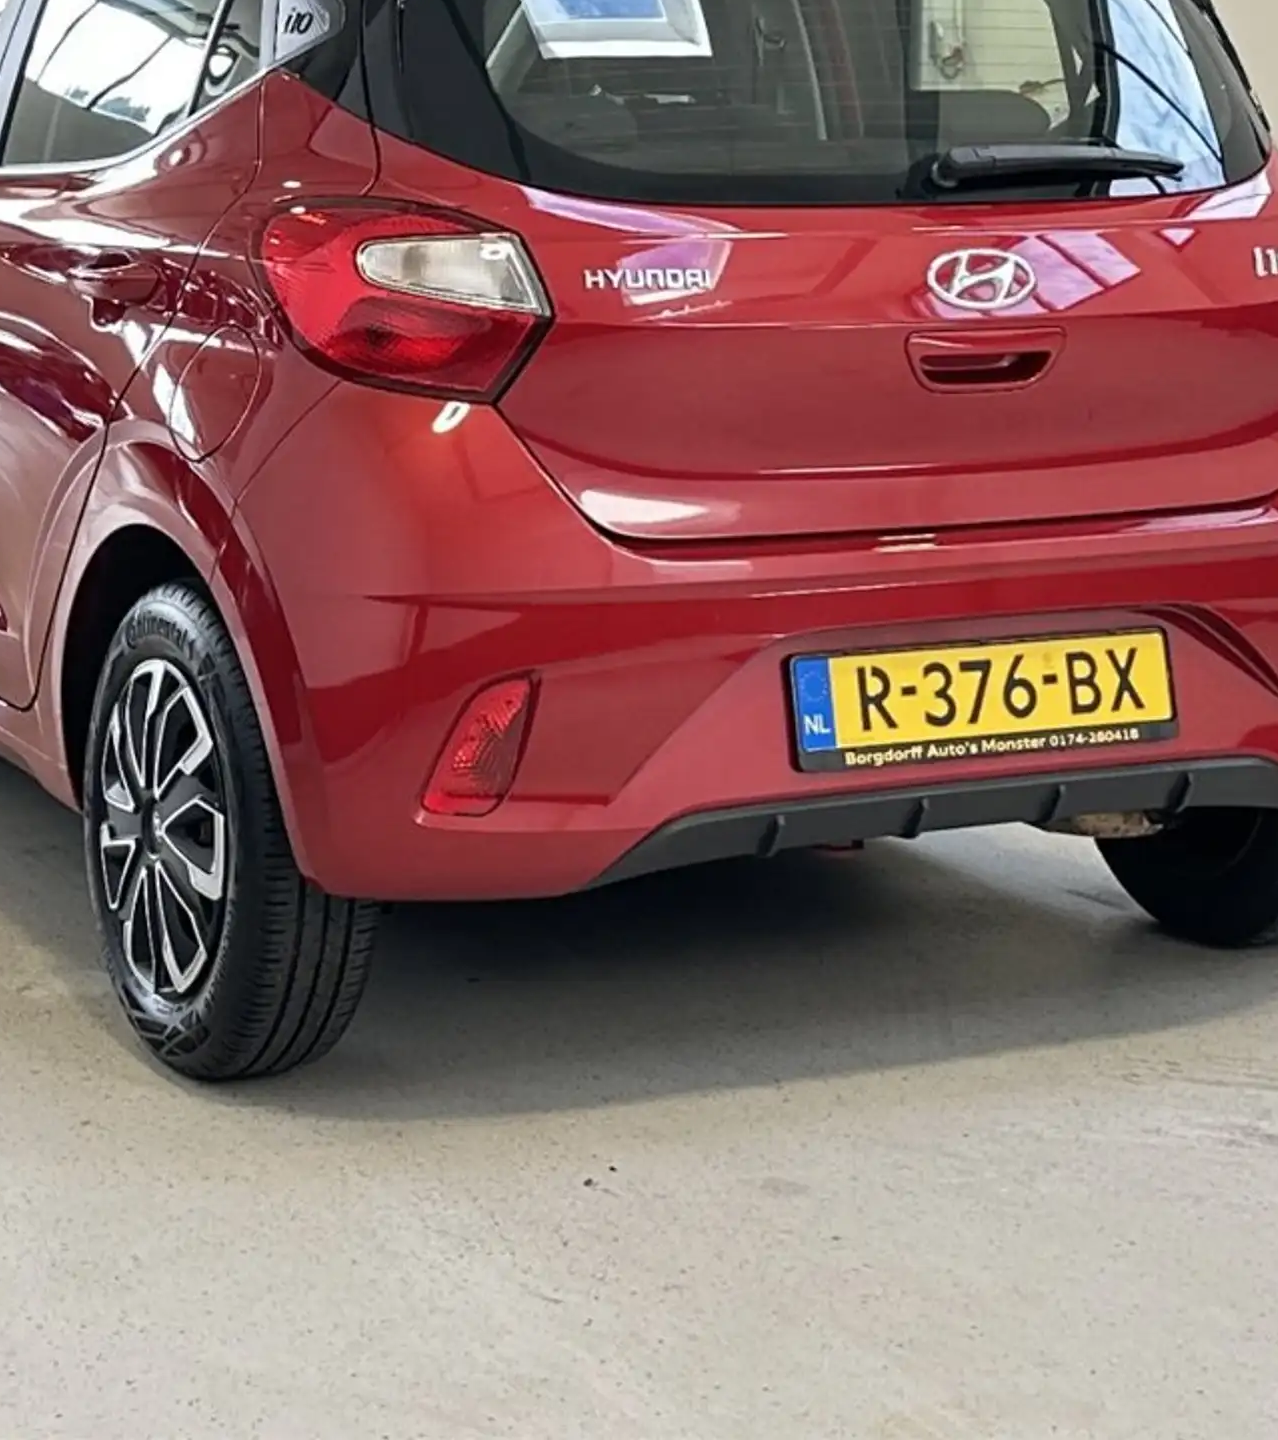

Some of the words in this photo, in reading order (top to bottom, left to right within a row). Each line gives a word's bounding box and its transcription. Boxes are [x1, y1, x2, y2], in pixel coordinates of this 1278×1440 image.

[283, 7, 314, 34] i10
[583, 268, 712, 290] HYUNDAI
[856, 647, 1145, 732] R-376-BX
[803, 713, 831, 735] NL
[844, 744, 924, 768] Borgdorff
[927, 740, 979, 760] Auto's
[981, 734, 1046, 755] Monster
